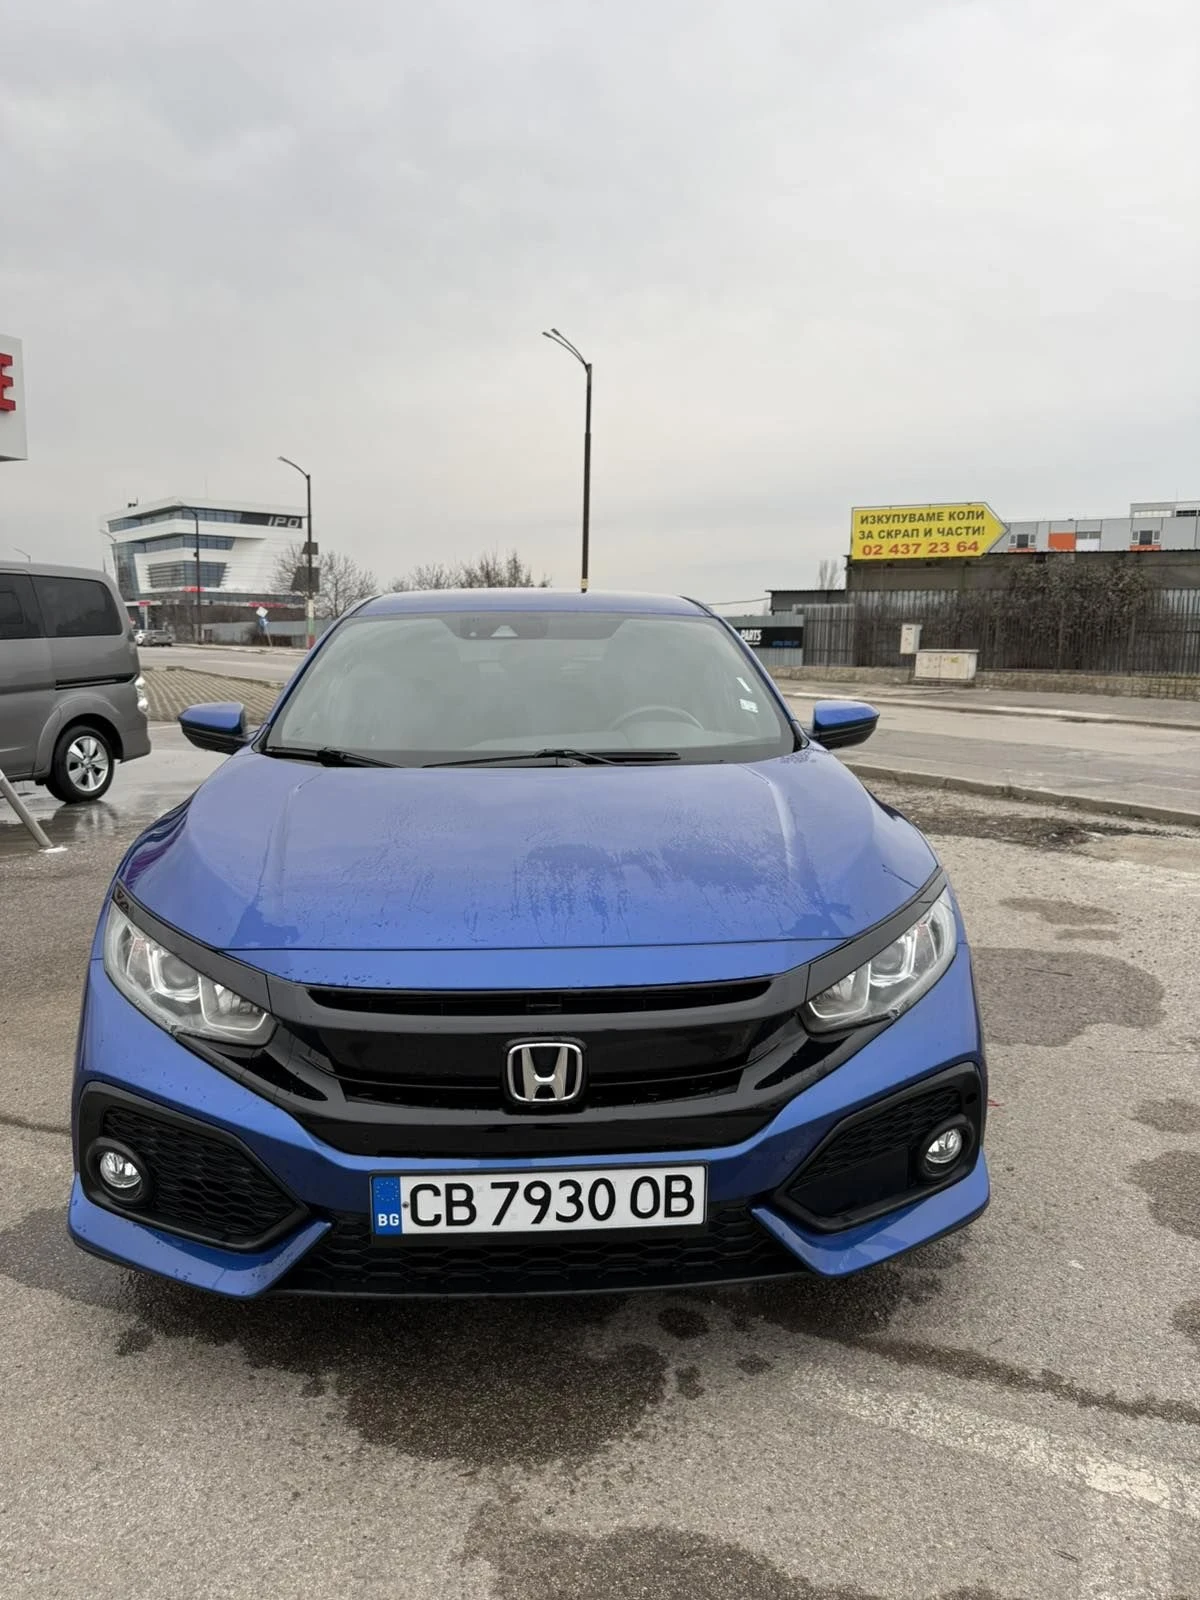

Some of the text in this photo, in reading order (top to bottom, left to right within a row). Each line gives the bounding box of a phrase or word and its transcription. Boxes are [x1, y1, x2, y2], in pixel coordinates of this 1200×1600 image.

[267, 516, 300, 528] IPO
[860, 510, 985, 525] ИЗКУПУВАМЕ КОЛИ
[858, 526, 985, 540] ЗА СКРАП И ЧАСТИ!
[862, 541, 979, 556] 02 437 23 64
[740, 629, 762, 641] PARTS
[378, 1174, 695, 1227] BG CB 7930 OB
